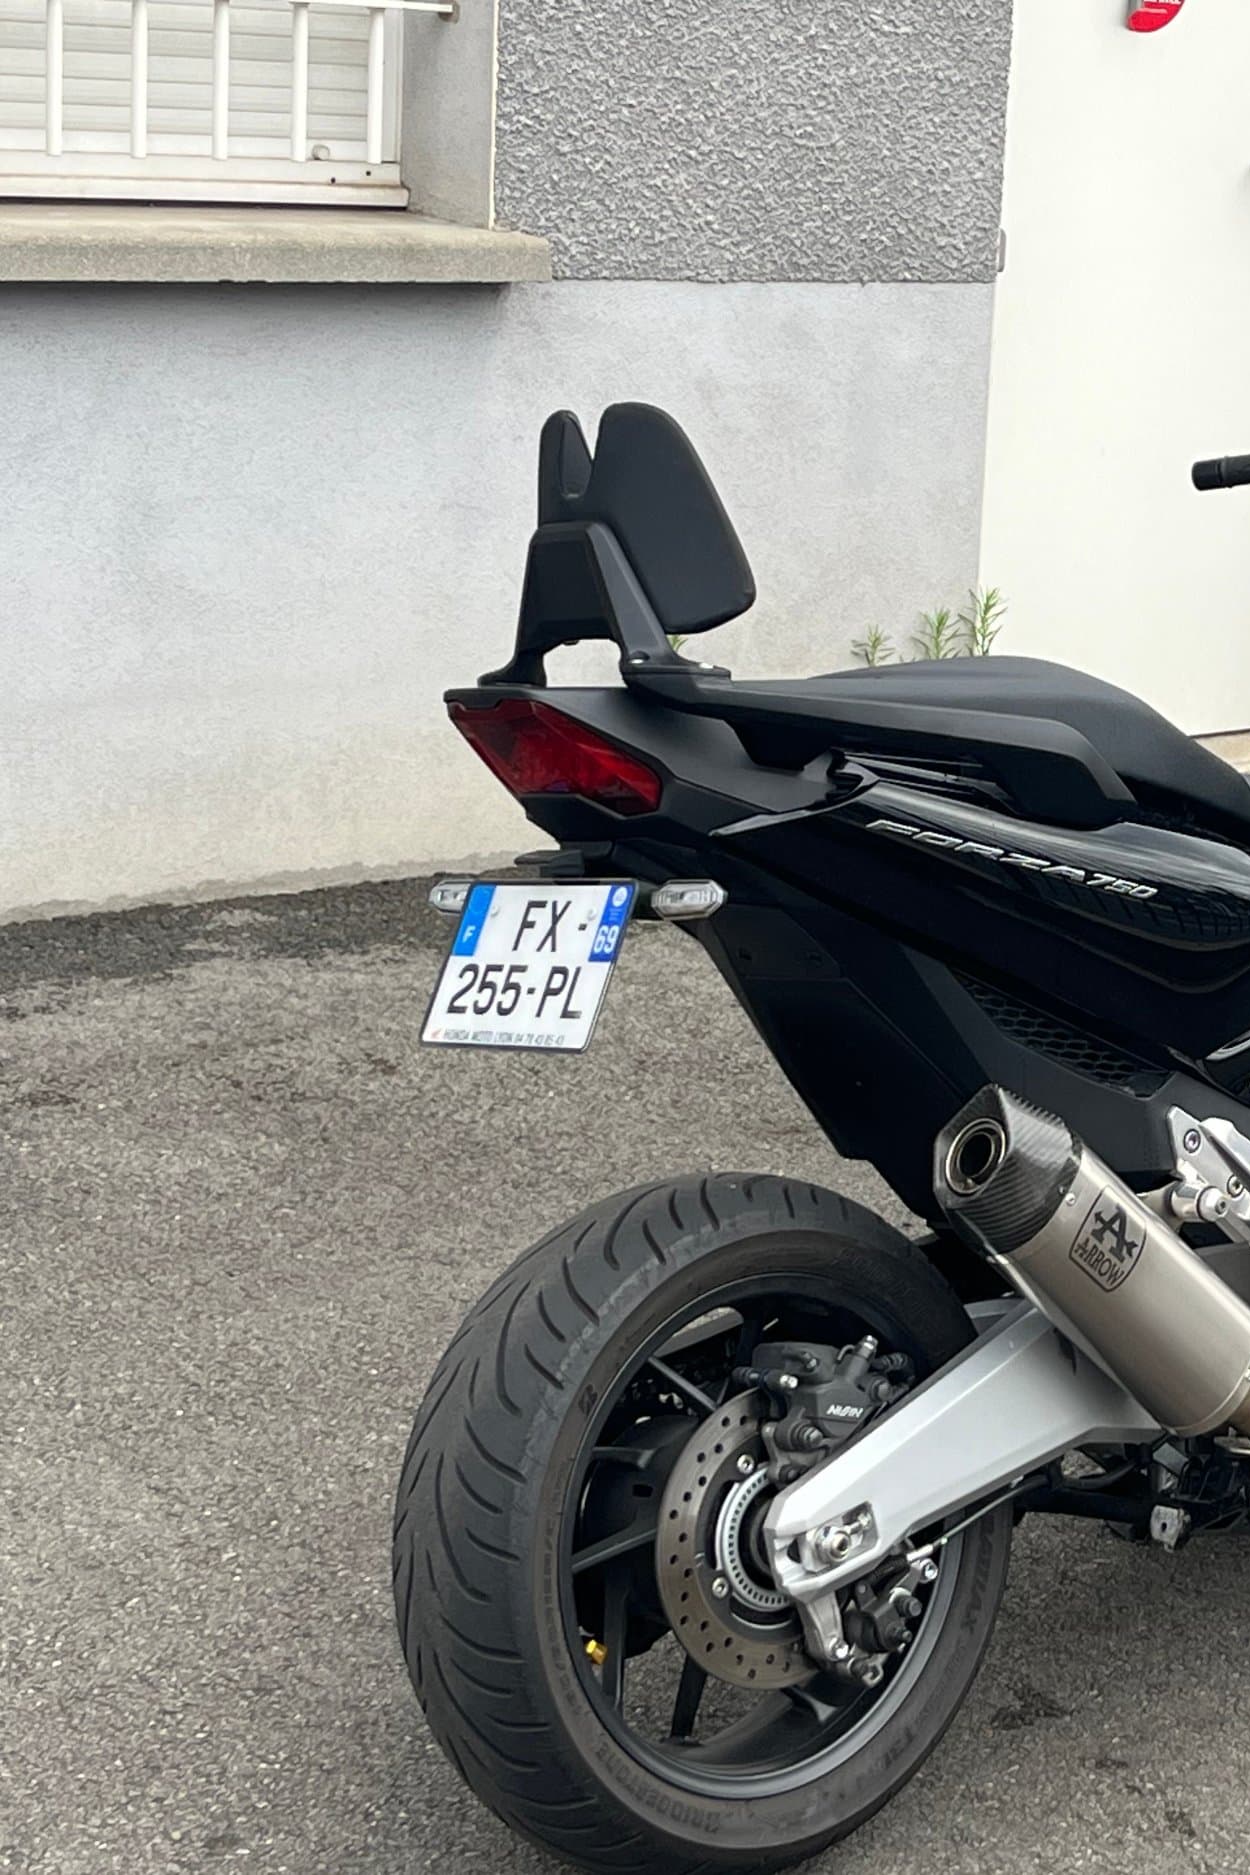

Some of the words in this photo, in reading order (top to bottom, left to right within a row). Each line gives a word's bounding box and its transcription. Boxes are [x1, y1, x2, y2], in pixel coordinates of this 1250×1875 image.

[866, 819, 1086, 883] FORZA
[1086, 873, 1159, 899] 750
[462, 926, 473, 941] F
[594, 925, 619, 954] 69
[446, 963, 582, 1020] 255-PL
[1074, 1237, 1125, 1286] ARROW
